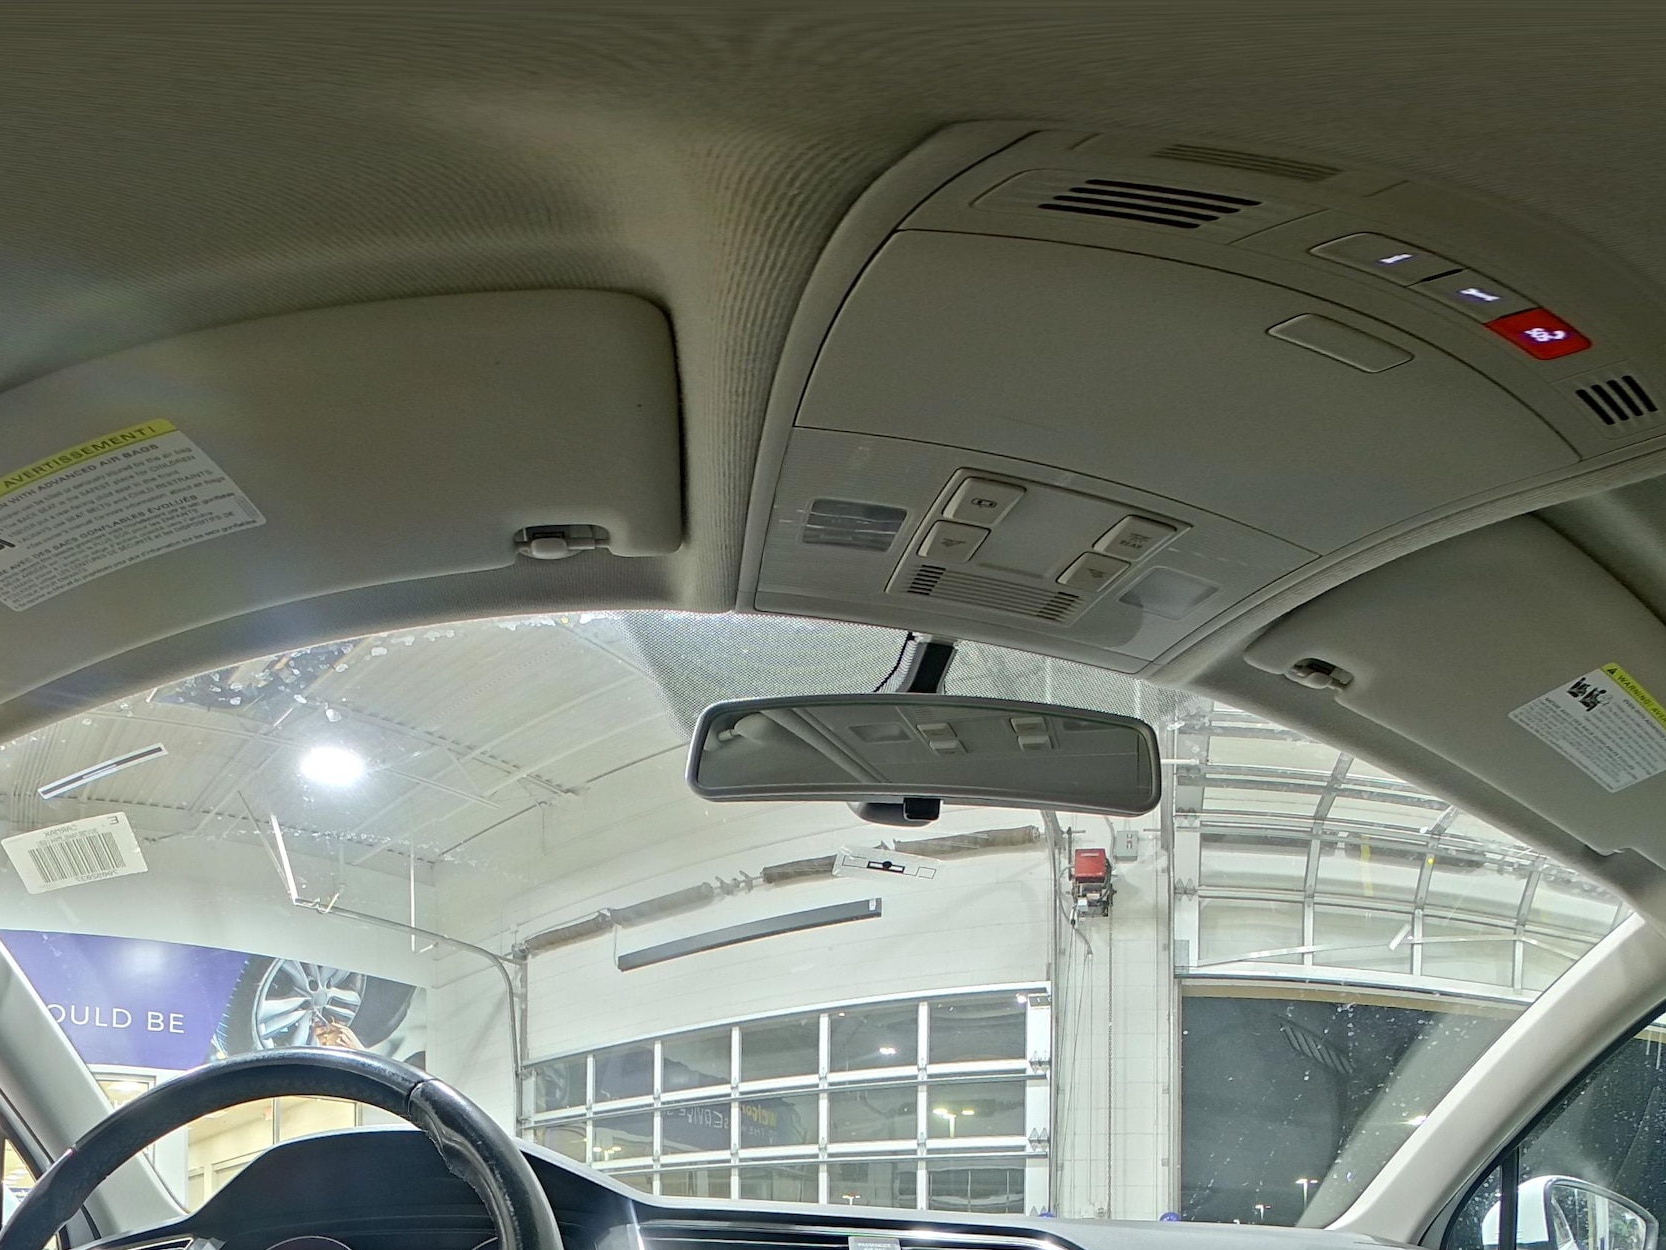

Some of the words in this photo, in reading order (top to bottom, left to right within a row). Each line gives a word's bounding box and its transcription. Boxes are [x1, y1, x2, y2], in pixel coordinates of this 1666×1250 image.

[0, 425, 156, 488] AVERTISSEMENT!
[7, 489, 37, 504] WITH
[34, 463, 98, 491] ADVANCED
[97, 455, 121, 466] AIR
[121, 442, 159, 459] BAGS
[1618, 675, 1652, 707] WARNING!
[46, 1003, 133, 1029] OULD
[147, 1011, 185, 1034] BE
